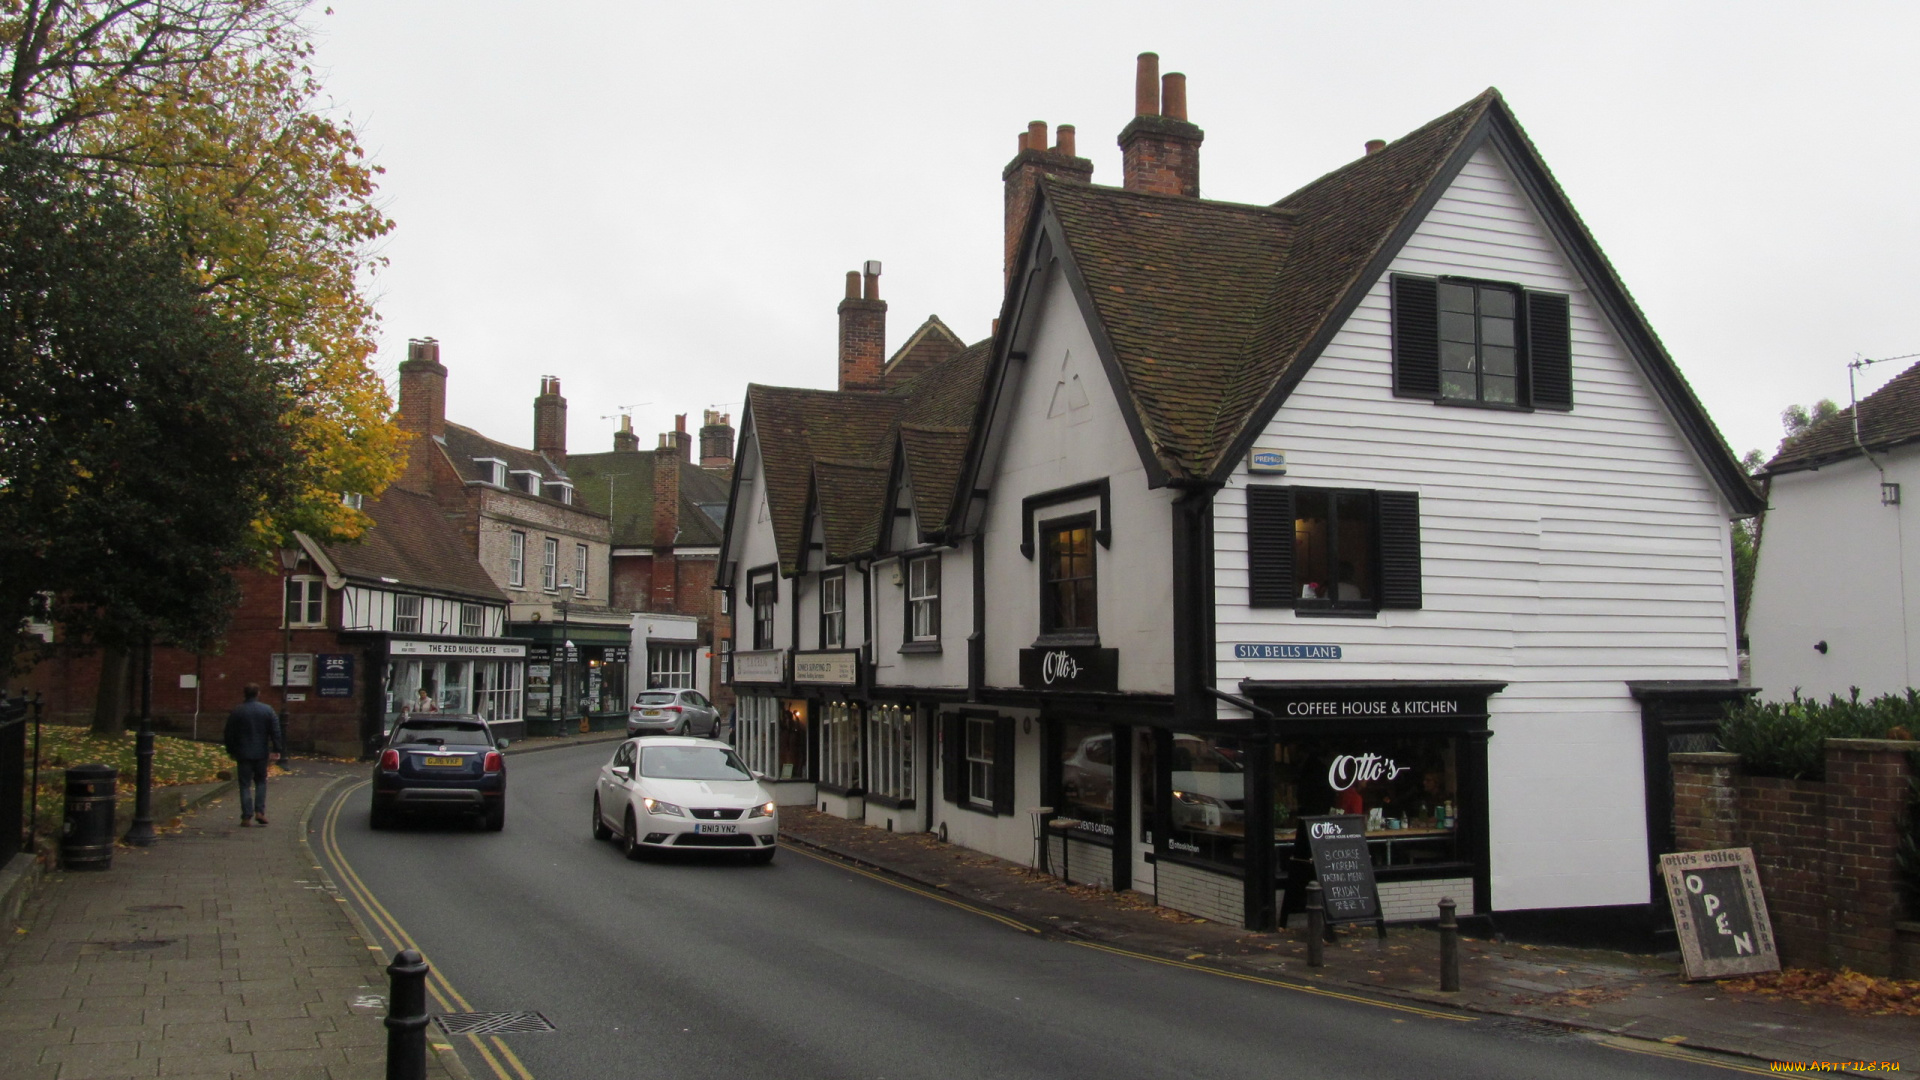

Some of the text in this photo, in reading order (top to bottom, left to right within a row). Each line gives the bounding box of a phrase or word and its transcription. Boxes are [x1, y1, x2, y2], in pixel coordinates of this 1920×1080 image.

[429, 644, 442, 652] THE
[459, 646, 480, 654] MUSIC
[1240, 645, 1338, 658] SIX BELLS LANE
[1043, 650, 1083, 685] Otto's
[1287, 701, 1457, 715] COFFEE HOUSE & KITCHEN
[1329, 753, 1410, 791] Otto's
[702, 824, 736, 833] BN13 YNZ
[1095, 823, 1114, 835] CATERIN
[1311, 822, 1343, 839] Otto's
[1333, 849, 1360, 860] COURSE
[1665, 851, 1741, 866] otto's coffee
[1322, 873, 1346, 882] TASTING
[1331, 886, 1360, 899] FRIDAY
[1671, 874, 1690, 931] house
[1686, 875, 1753, 954] OPEN
